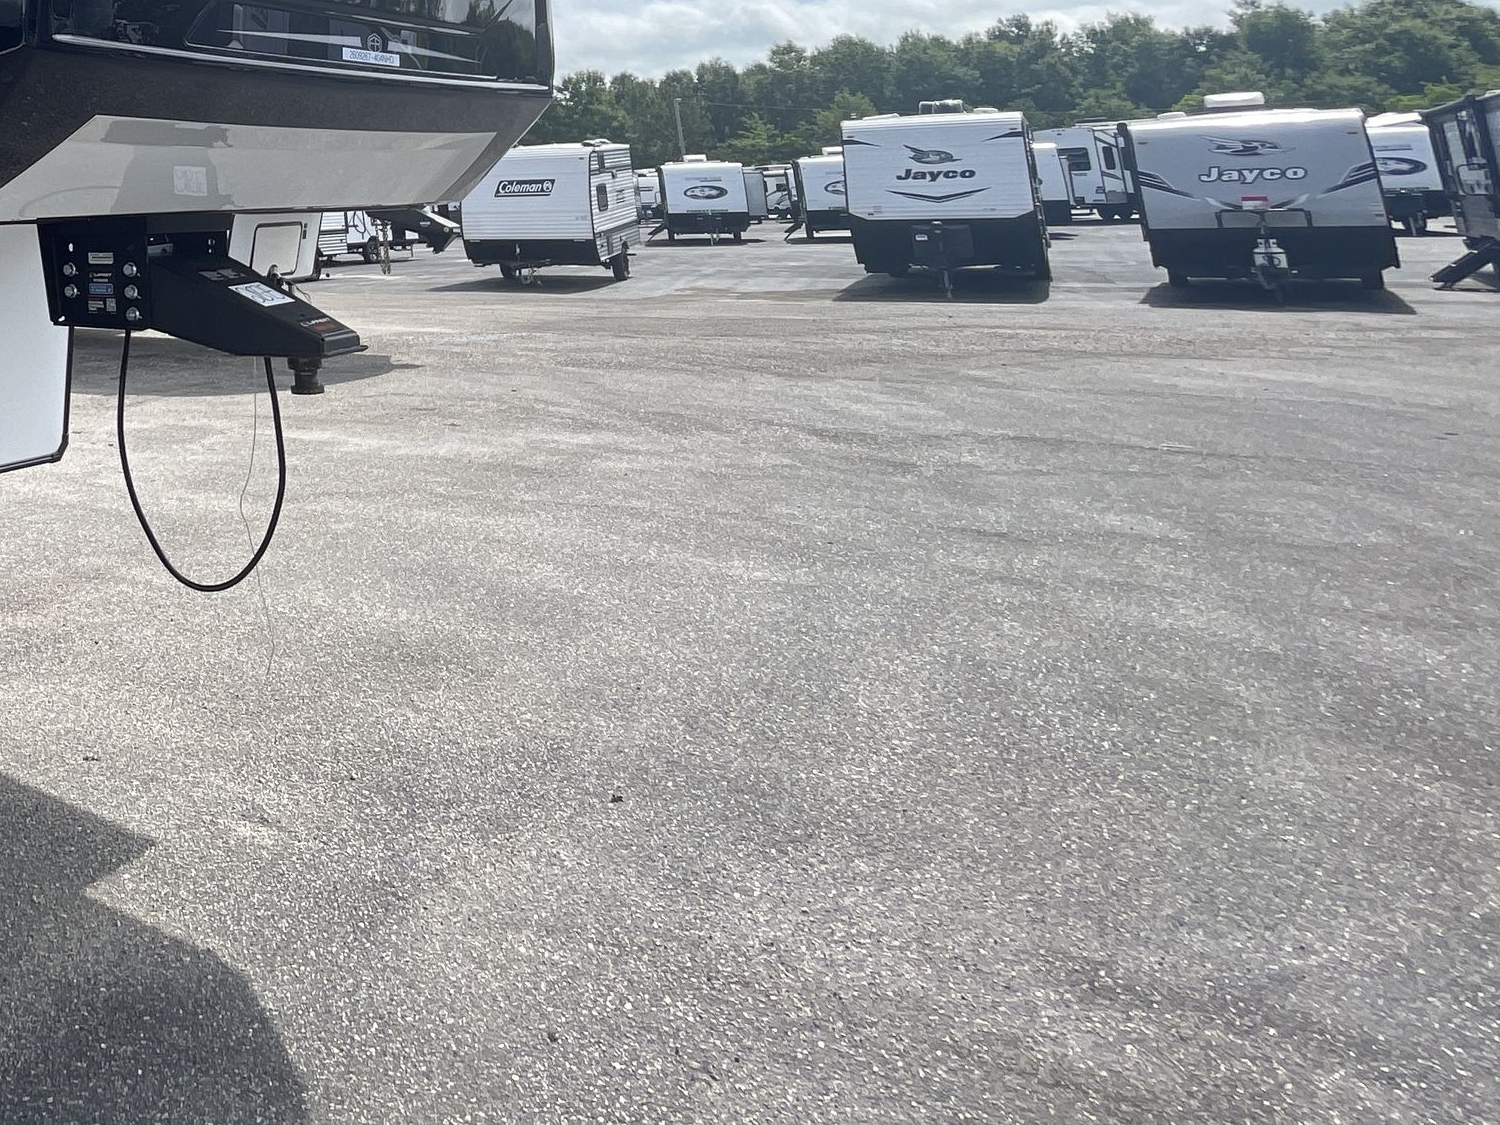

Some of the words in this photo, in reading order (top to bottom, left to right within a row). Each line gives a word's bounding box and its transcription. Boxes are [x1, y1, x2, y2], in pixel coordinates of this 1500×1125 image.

[896, 168, 976, 183] Jayco
[1198, 166, 1307, 185] Jayco
[498, 181, 542, 194] Coleman
